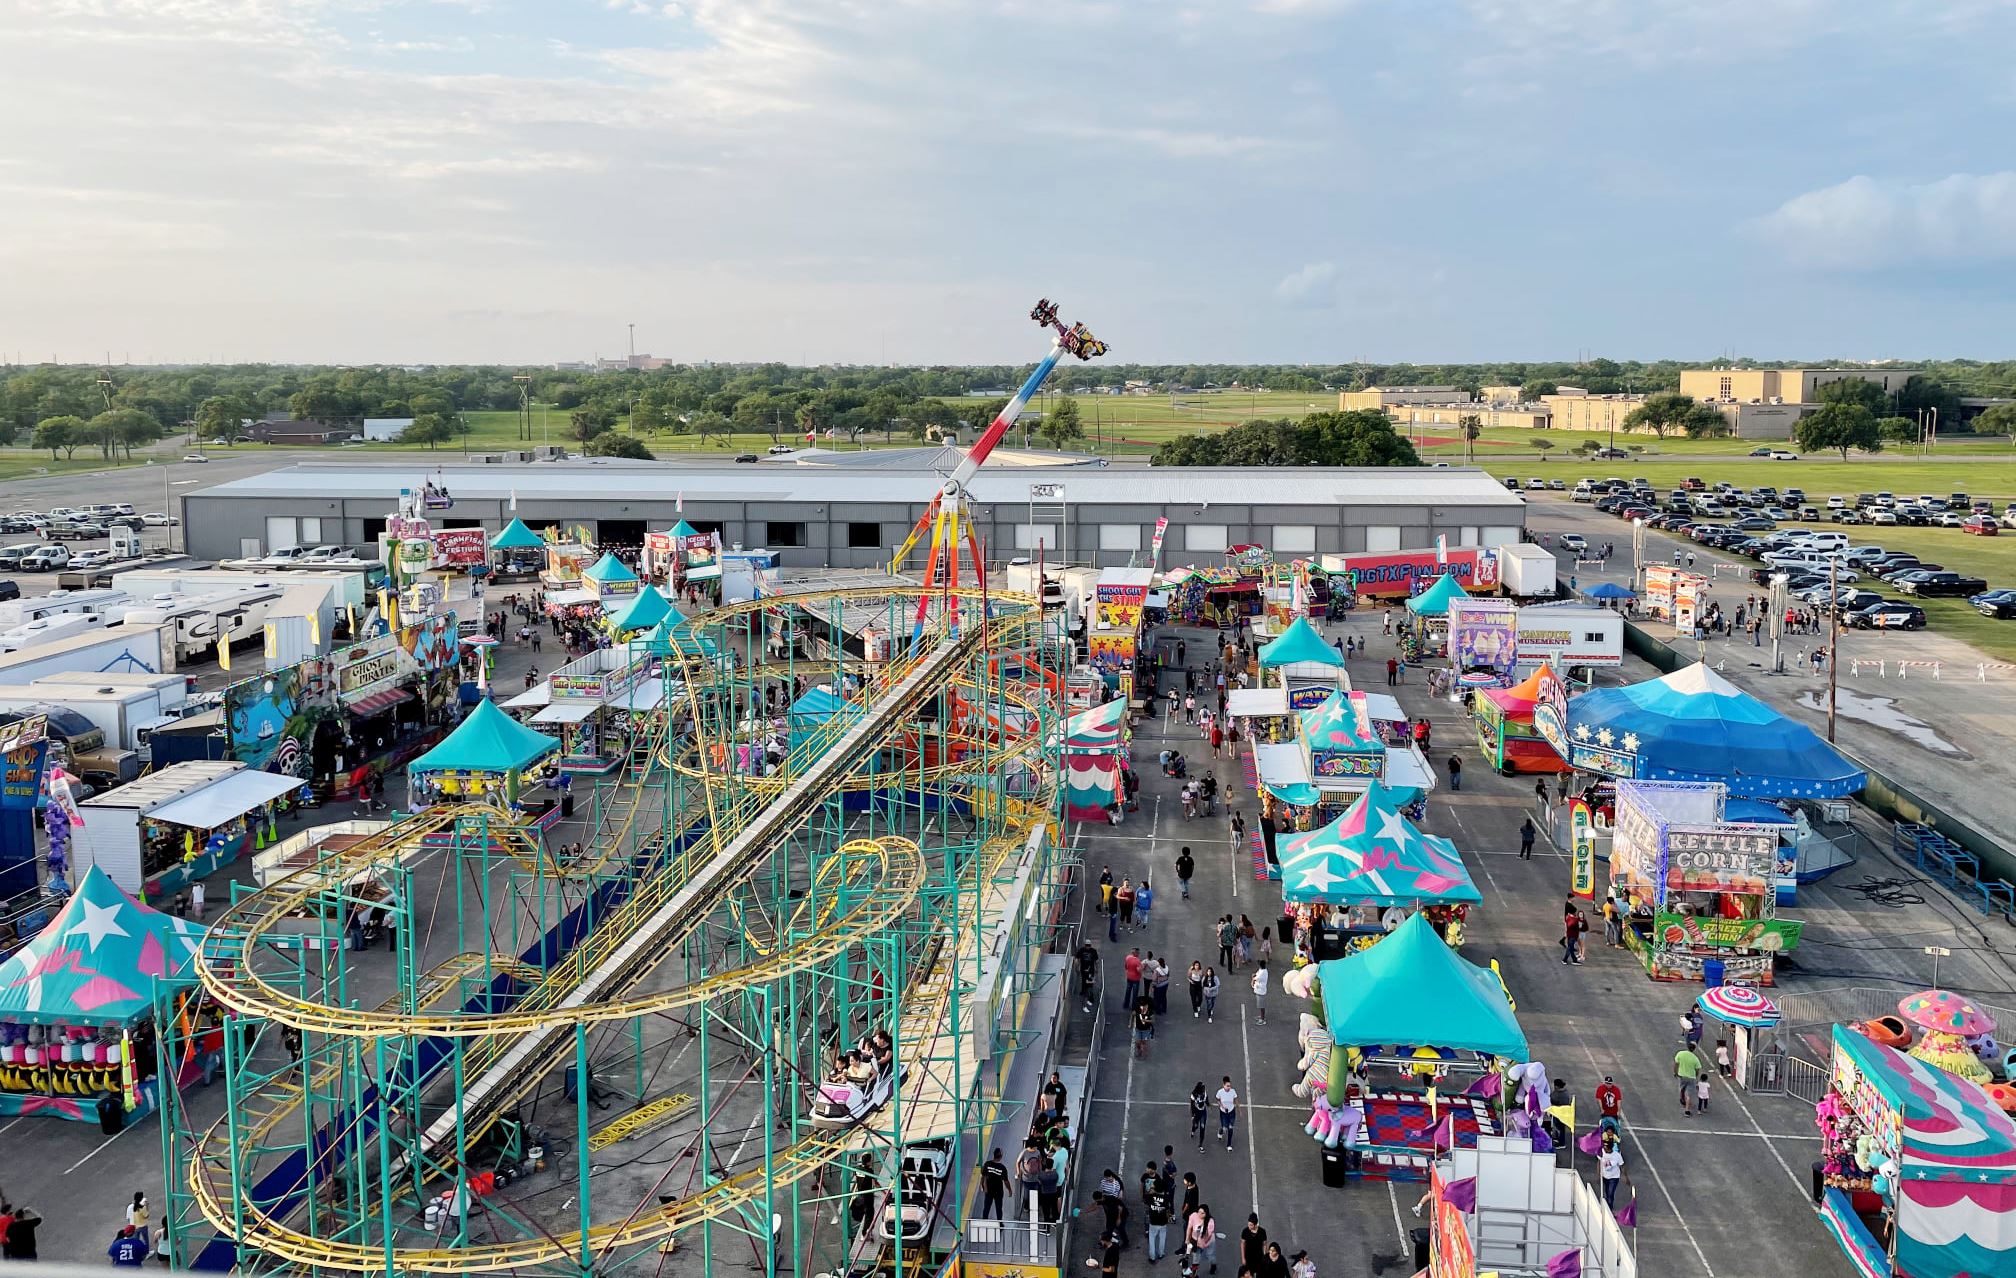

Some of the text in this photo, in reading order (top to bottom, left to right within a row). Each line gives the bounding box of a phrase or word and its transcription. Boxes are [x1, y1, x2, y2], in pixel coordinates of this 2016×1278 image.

[443, 535, 483, 547] CRAWFISH
[1113, 596, 1140, 606] STAR
[1485, 612, 1515, 624] WHIP
[352, 659, 381, 677] GHOST
[359, 664, 394, 684] PIRATES
[1668, 833, 1770, 853] KETTLE
[1676, 851, 1749, 870] CORN
[1703, 923, 1746, 934] STREET
[120, 1250, 133, 1260] 21
